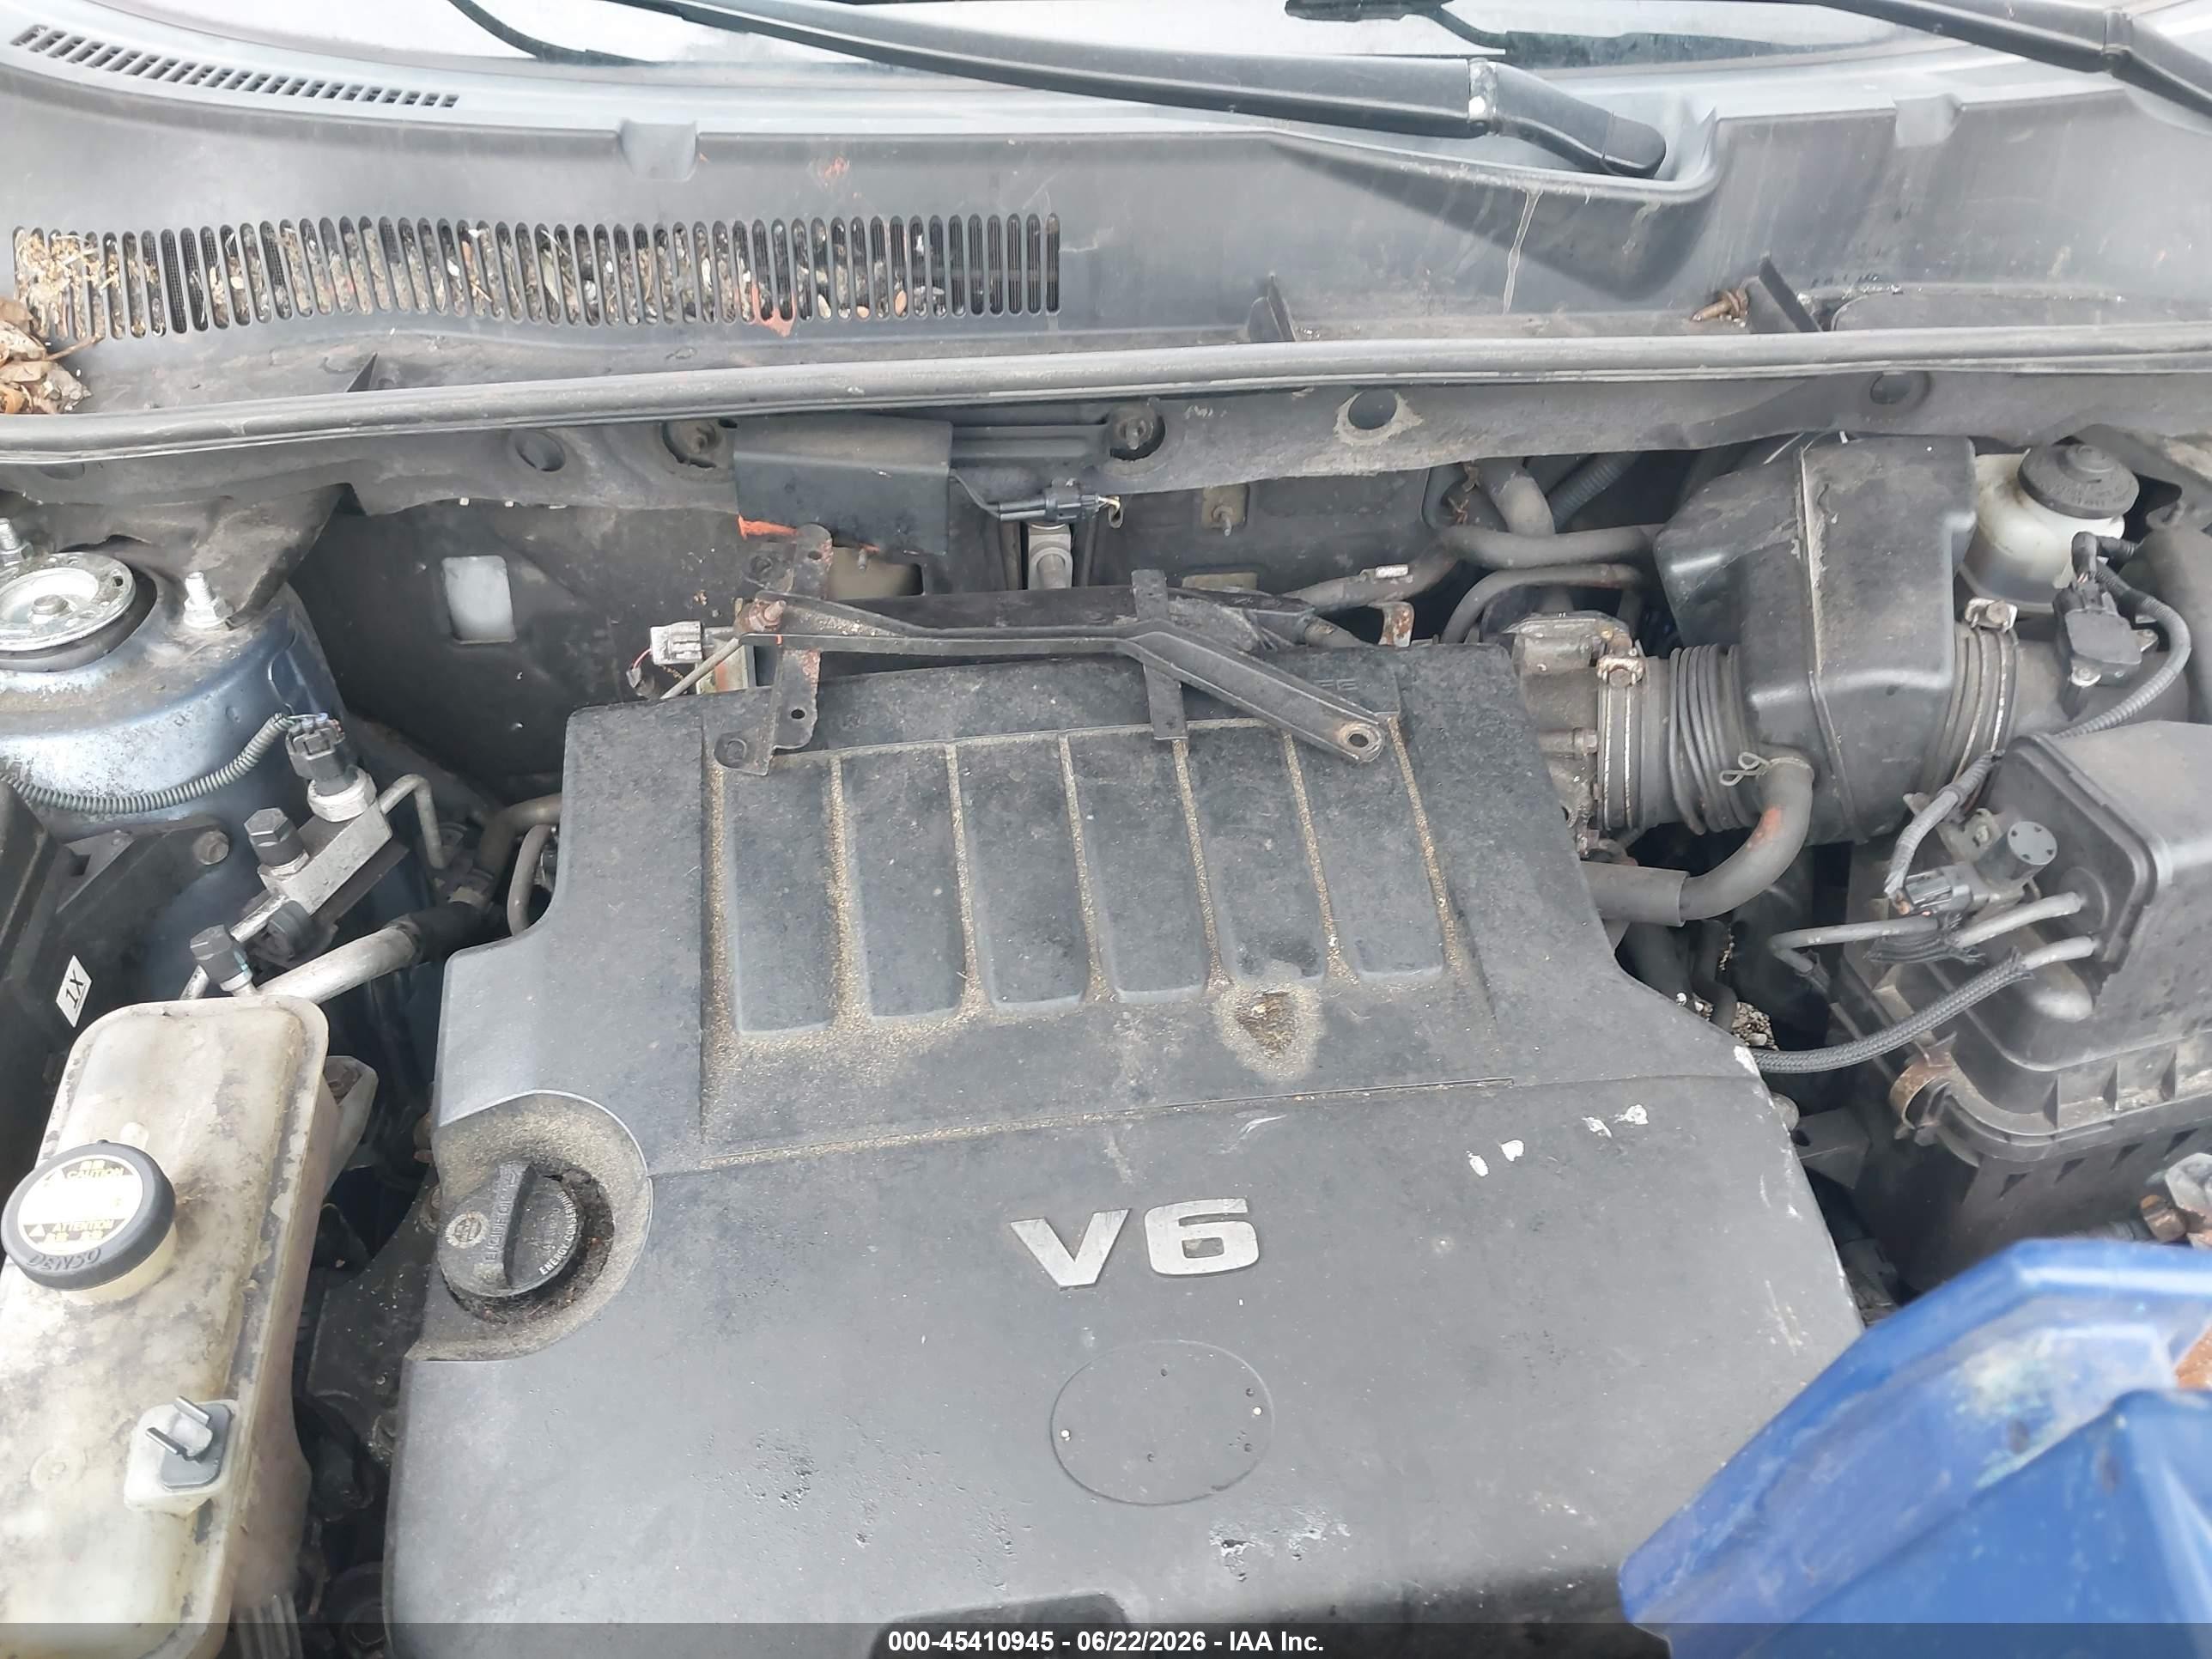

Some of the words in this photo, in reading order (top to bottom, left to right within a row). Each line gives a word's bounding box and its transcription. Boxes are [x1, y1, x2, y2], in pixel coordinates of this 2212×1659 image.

[66, 970, 84, 1008] 1X
[66, 1168, 124, 1179] CAUTION
[52, 1219, 114, 1233] ATTENTION
[538, 1243, 569, 1276] ENERGY
[556, 1191, 577, 1242] CONSERVING
[1010, 1198, 1260, 1288] V6
[27, 1248, 102, 1271] DENSO
